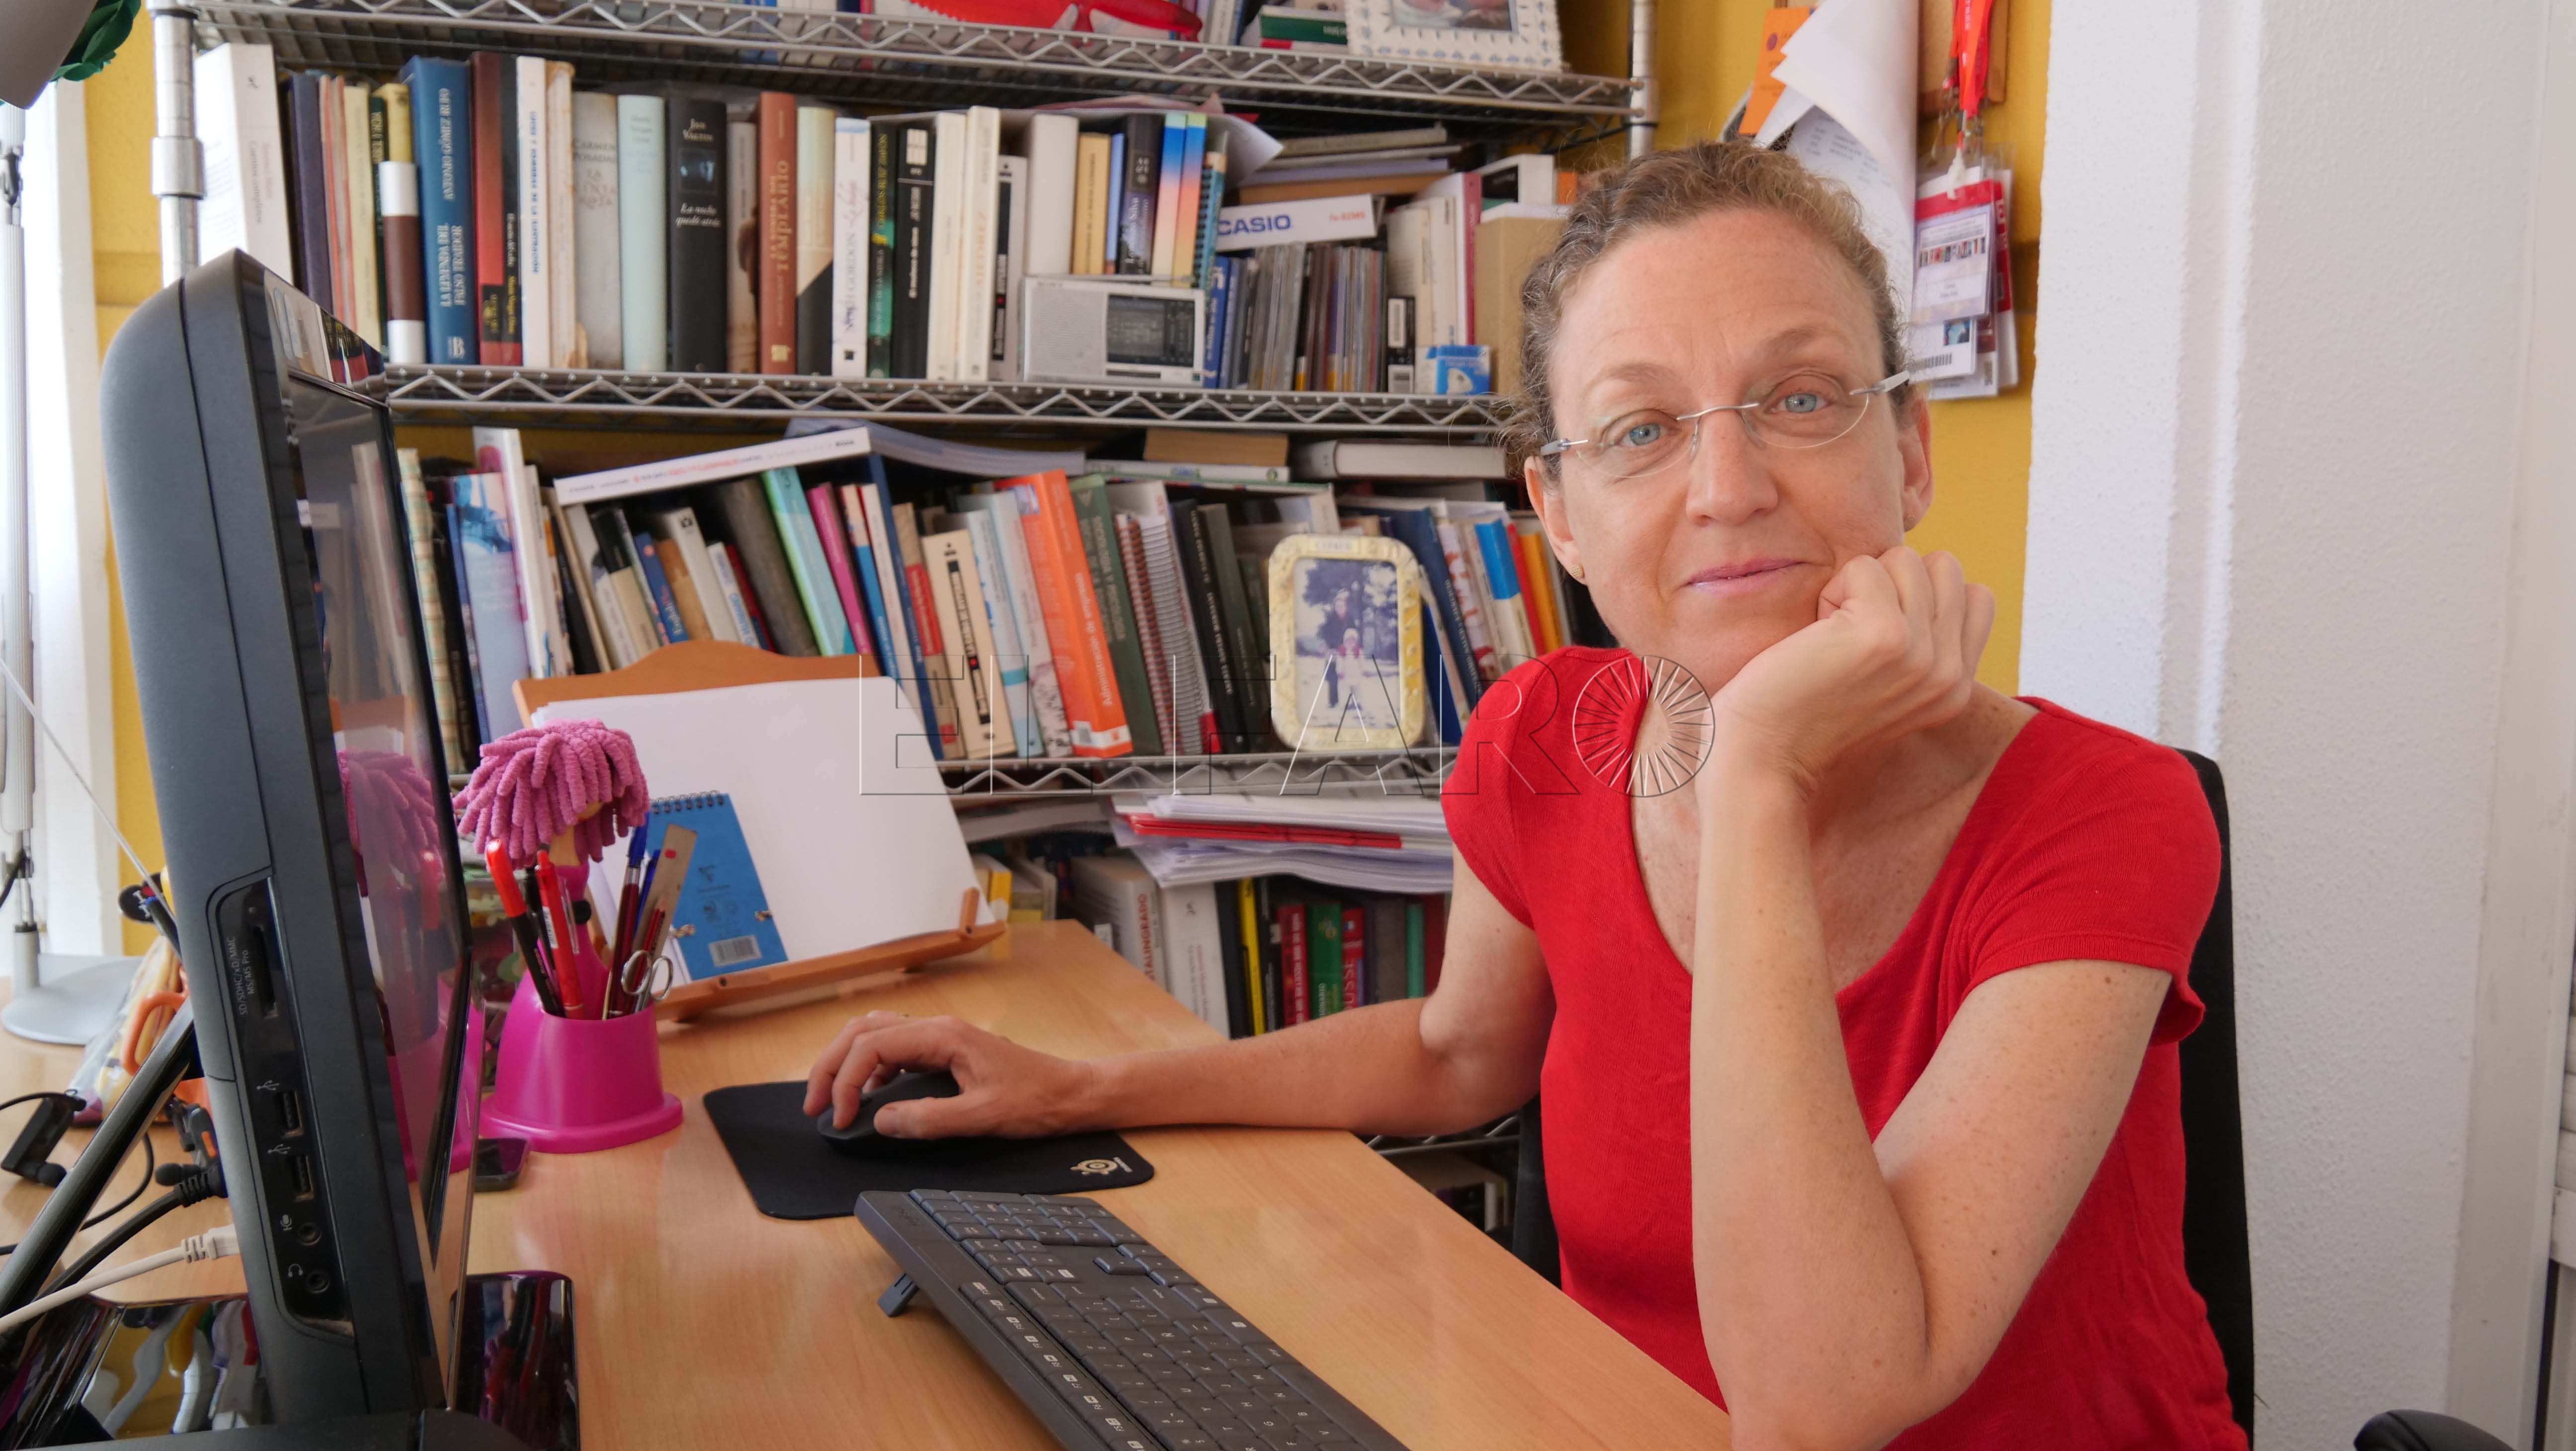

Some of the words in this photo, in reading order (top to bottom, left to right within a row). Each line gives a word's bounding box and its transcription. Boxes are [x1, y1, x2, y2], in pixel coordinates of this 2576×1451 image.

[249, 141, 262, 177] Cuentos
[574, 139, 616, 152] CARMEN
[441, 156, 455, 201] ANTONIO
[675, 216, 700, 229] quedó
[701, 218, 721, 228] atrás
[680, 203, 694, 215] La
[695, 205, 717, 216] noche
[775, 160, 791, 271] TEMPLARIO
[1127, 197, 1138, 221] Silva
[1217, 214, 1291, 235] CASIO
[437, 224, 450, 244] DEL
[452, 226, 465, 271] TRAIDOR
[438, 245, 451, 292] LEYENDA
[845, 232, 858, 291] GORDON
[440, 294, 452, 307] LA
[453, 273, 466, 306] FALSO
[1074, 573, 1093, 619] empresas
[1085, 621, 1097, 636] de
[1090, 638, 1114, 708] Administración
[242, 950, 250, 963] Pro
[227, 937, 249, 1016] SD/SDHC/xD/MMC
[243, 966, 255, 995] MS/MS
